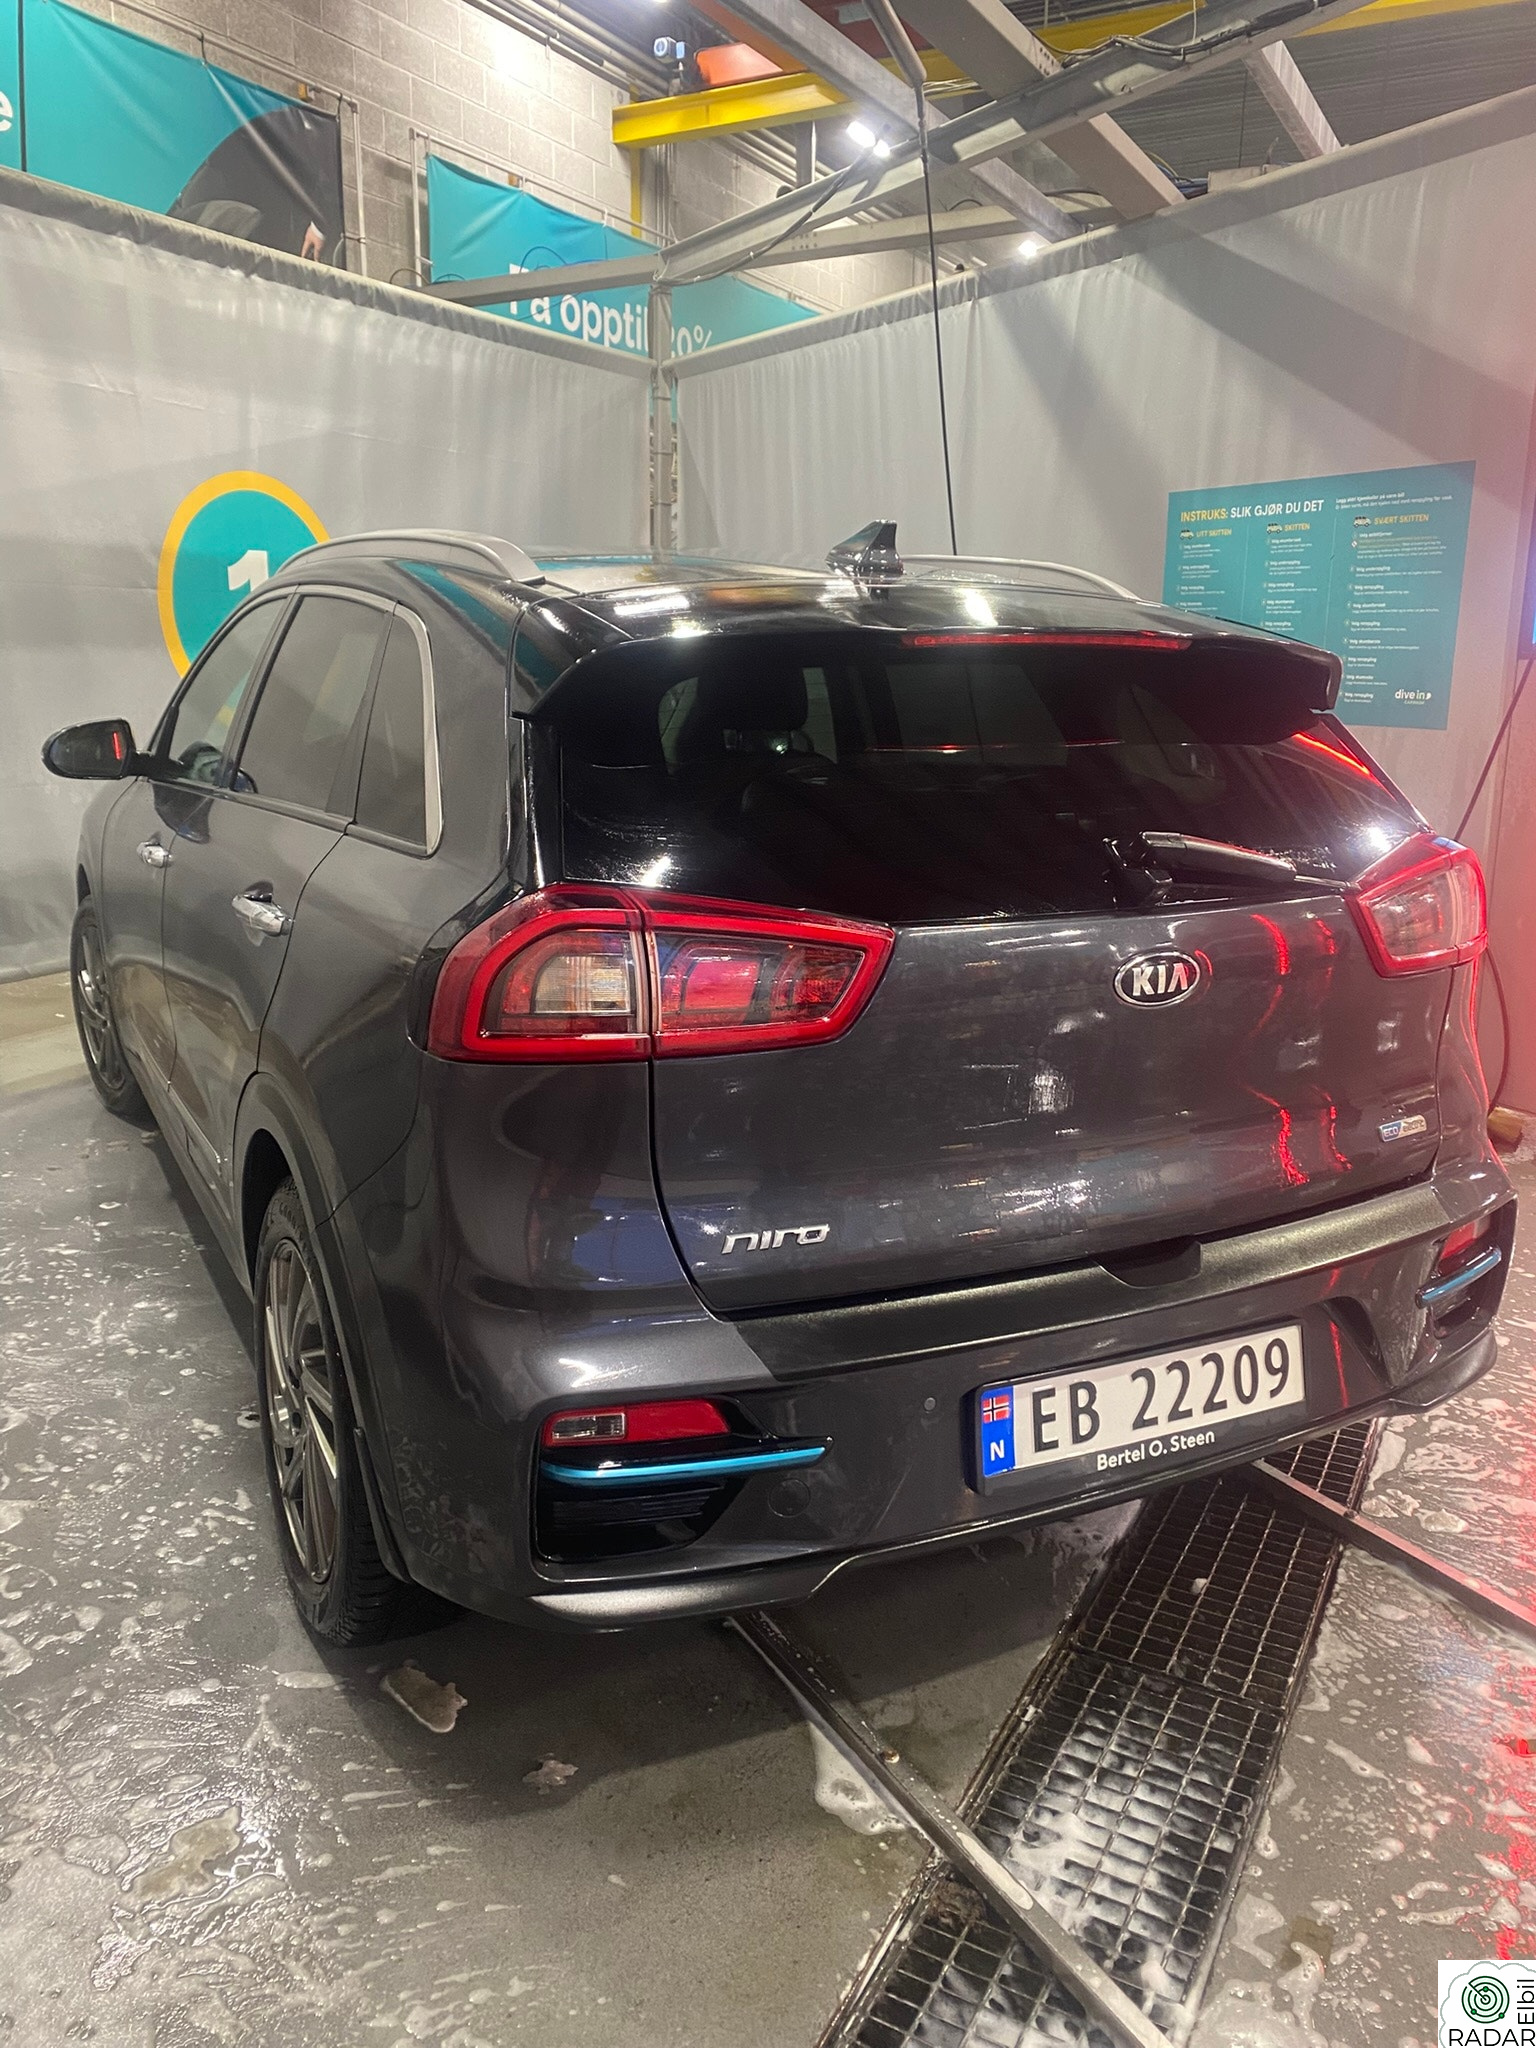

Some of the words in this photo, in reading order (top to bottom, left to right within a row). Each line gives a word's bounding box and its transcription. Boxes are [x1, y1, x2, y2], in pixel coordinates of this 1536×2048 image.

[1180, 508, 1229, 522] INSTRUKS:
[1230, 506, 1252, 518] SLIK
[1254, 503, 1283, 516] GJØR
[1285, 501, 1301, 514] DU
[1303, 499, 1325, 513] DET
[1399, 514, 1430, 523] SKITTEN
[1284, 523, 1311, 532] SKITTEN
[1394, 689, 1416, 700] dive
[1416, 690, 1425, 700] in
[1131, 962, 1188, 997] KIA
[721, 1223, 830, 1255] niro
[1031, 1380, 1101, 1453] EB
[1131, 1337, 1290, 1431] 22209
[990, 1439, 1004, 1461] N
[1097, 1448, 1146, 1471] Bertel
[1148, 1440, 1168, 1457] O.
[1170, 1430, 1215, 1453] Steen
